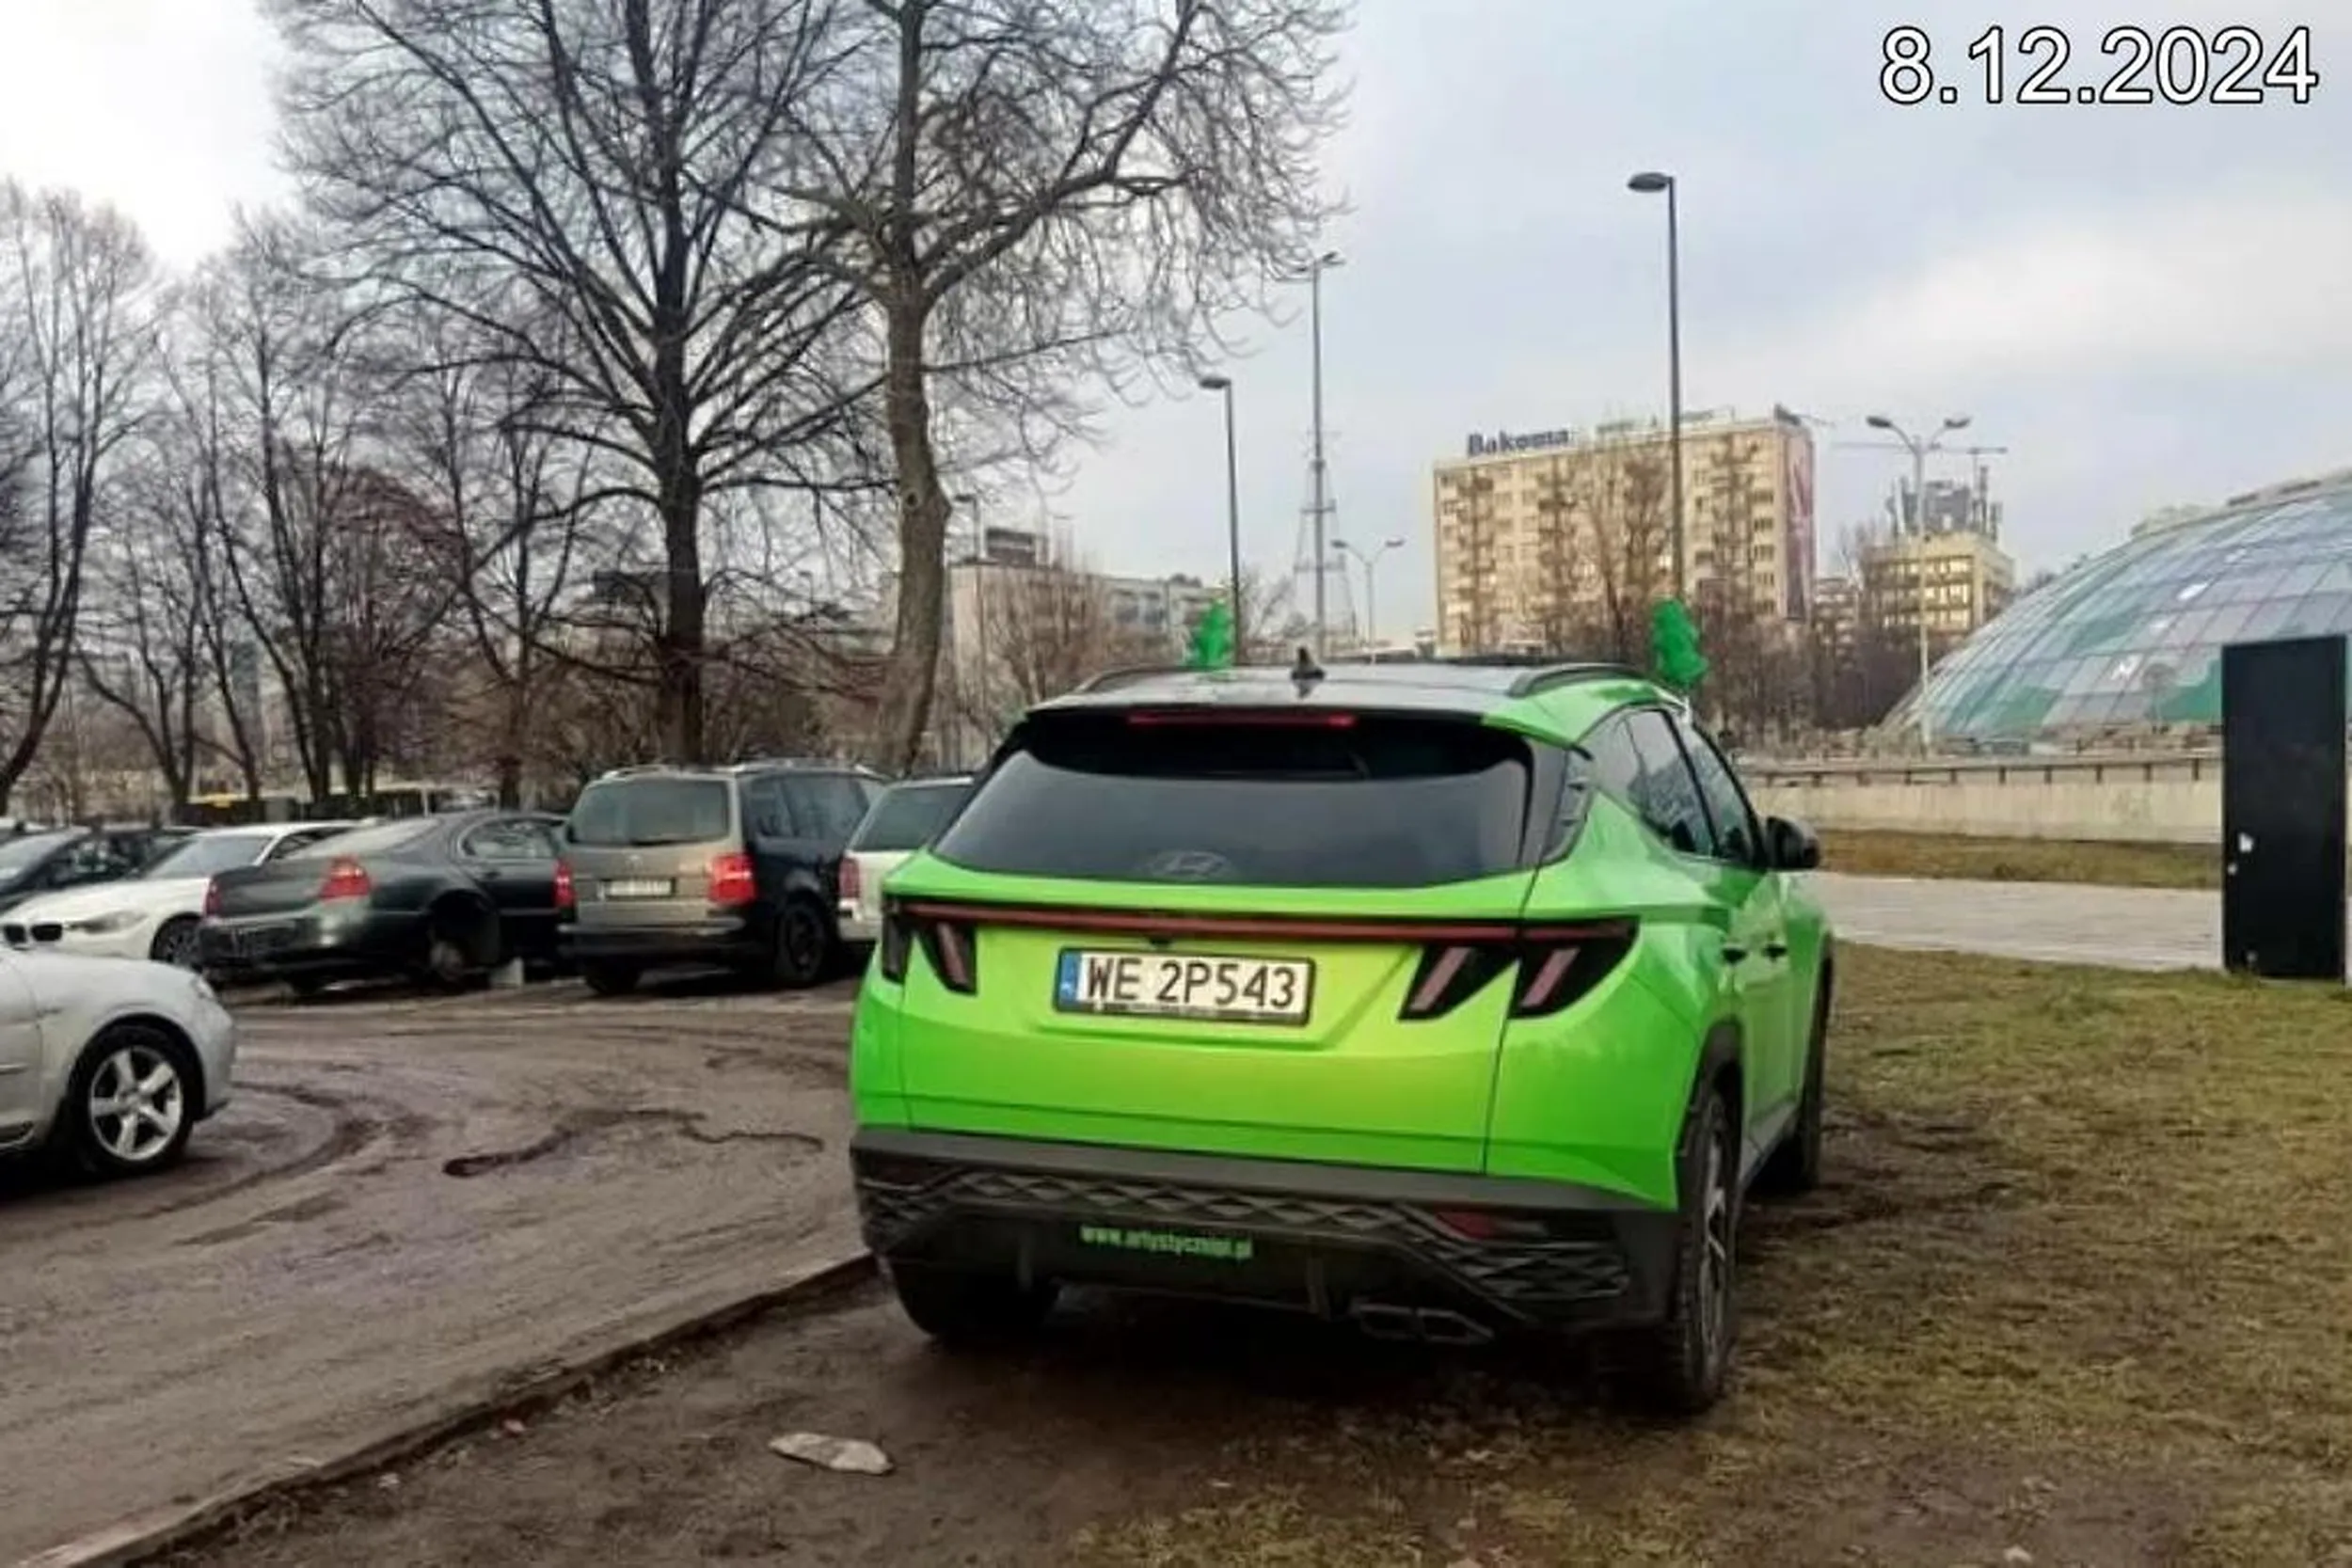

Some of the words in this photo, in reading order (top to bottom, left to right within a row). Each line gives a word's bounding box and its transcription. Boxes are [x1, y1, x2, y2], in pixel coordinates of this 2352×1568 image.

[1467, 429, 1569, 458] Bakoma
[1088, 957, 1142, 1001] WE
[1155, 961, 1296, 1009] 2P543
